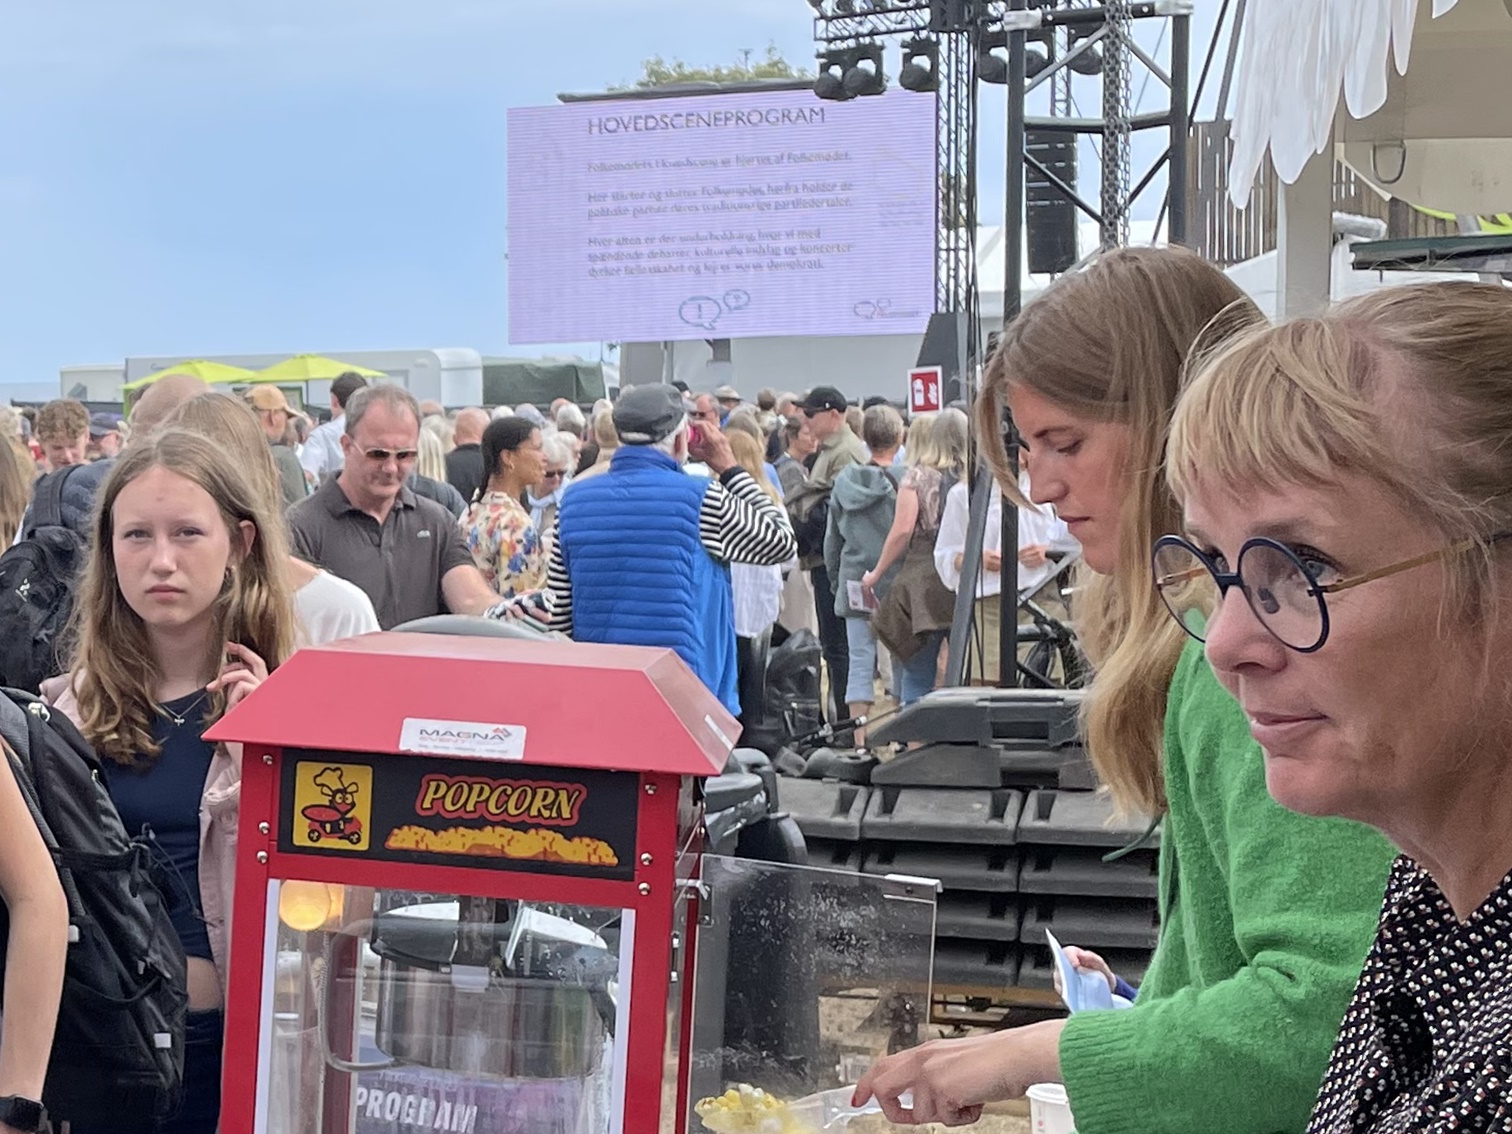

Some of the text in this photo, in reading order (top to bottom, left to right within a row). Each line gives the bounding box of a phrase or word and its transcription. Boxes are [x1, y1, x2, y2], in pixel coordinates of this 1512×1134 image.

[588, 107, 825, 135] HOVEDSCENEPROGRAM
[420, 728, 505, 742] MAGNA
[420, 780, 581, 821] POPCORN
